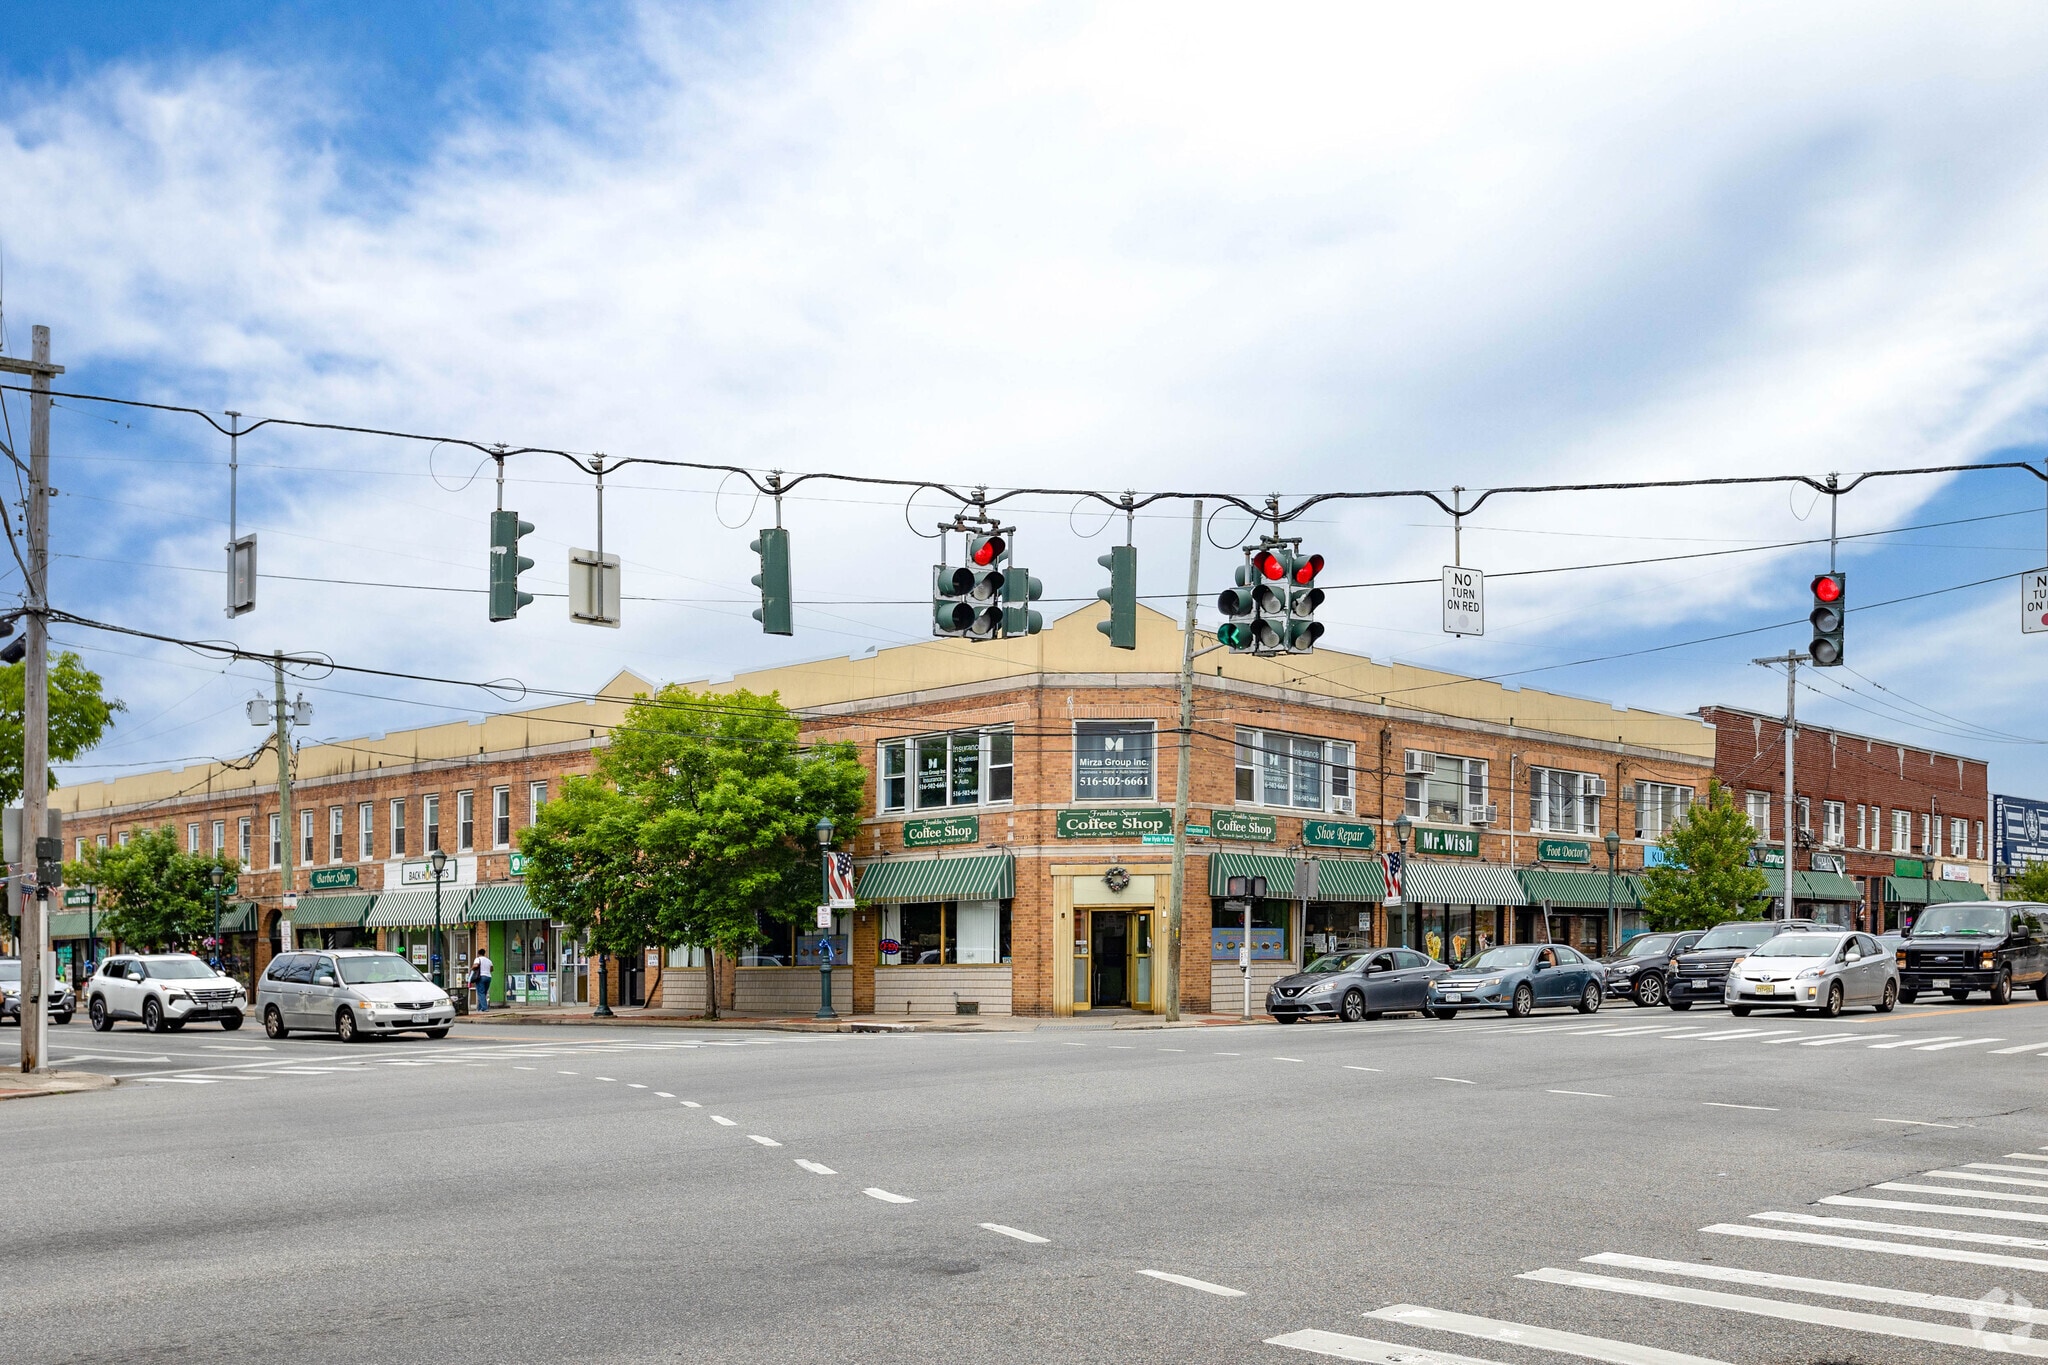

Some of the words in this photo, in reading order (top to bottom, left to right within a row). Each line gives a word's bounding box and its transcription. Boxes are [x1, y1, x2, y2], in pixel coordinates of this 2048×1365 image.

[1454, 573, 1472, 587] NO
[1451, 587, 1475, 599] TURN
[2033, 589, 2047, 599] TU
[1447, 599, 1460, 610] ON
[1462, 601, 1480, 613] RED
[2027, 601, 2043, 612] ON
[958, 755, 978, 763] Business
[1079, 758, 1103, 766] Mirza
[1104, 758, 1132, 768] Group
[1133, 758, 1149, 766] Inc.
[958, 766, 972, 774] Home
[1079, 776, 1149, 786] 516-502-6661
[1088, 809, 1118, 818] Franklin
[1119, 809, 1142, 817] Square
[922, 818, 942, 828] Franklin
[1066, 818, 1118, 830] Coffee
[1122, 817, 1164, 832] Shop
[1217, 819, 1246, 832] Coffee
[1248, 822, 1272, 837] Shop
[909, 827, 942, 840] Coffee
[944, 825, 972, 838] Shop
[1315, 823, 1335, 840] Shoe
[1337, 827, 1365, 846] Repair
[1152, 836, 1161, 844] Hyde
[1546, 844, 1561, 857] Foot
[1561, 845, 1584, 858] Doctor
[316, 871, 335, 884] Barber
[335, 870, 351, 885] Shop
[409, 871, 421, 881] BACK
[880, 942, 898, 951] OPEN
